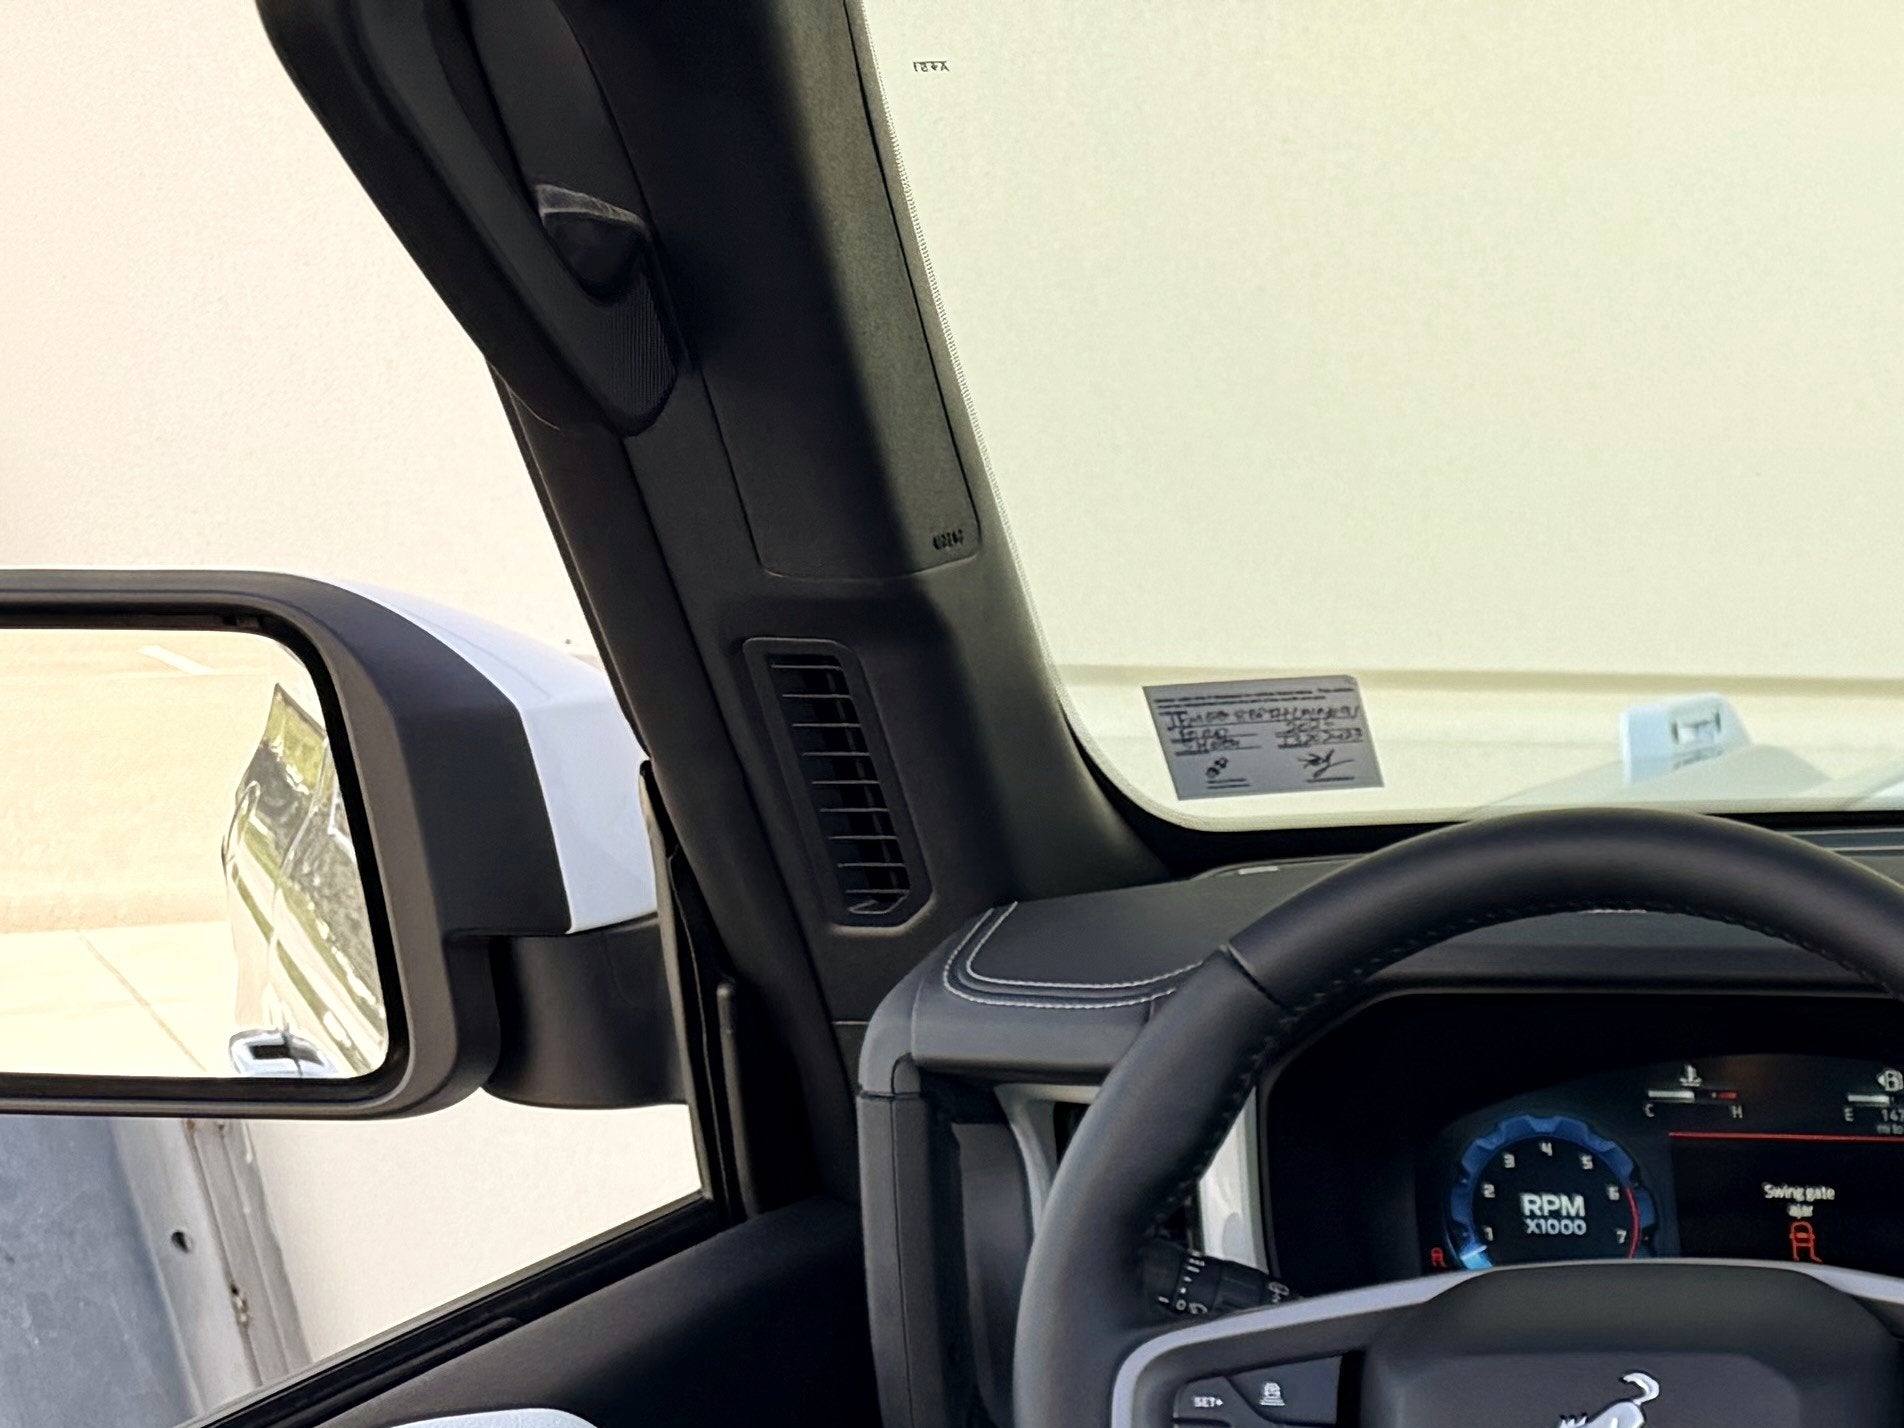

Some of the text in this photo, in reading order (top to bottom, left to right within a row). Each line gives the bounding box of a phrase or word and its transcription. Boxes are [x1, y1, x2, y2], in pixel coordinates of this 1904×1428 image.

[1644, 1104, 1655, 1118] C
[1732, 1106, 1743, 1119] H
[1844, 1107, 1854, 1122] E
[1540, 1142, 1553, 1156] 4
[1503, 1154, 1516, 1168] 3
[1580, 1153, 1594, 1170] 5
[1482, 1184, 1495, 1198] 2
[1606, 1185, 1620, 1201] 6
[1763, 1184, 1836, 1202] Swing gate
[1520, 1193, 1586, 1217] RPM
[1525, 1218, 1587, 1235] X1000
[1484, 1227, 1494, 1241] 1
[1616, 1230, 1627, 1244] 7
